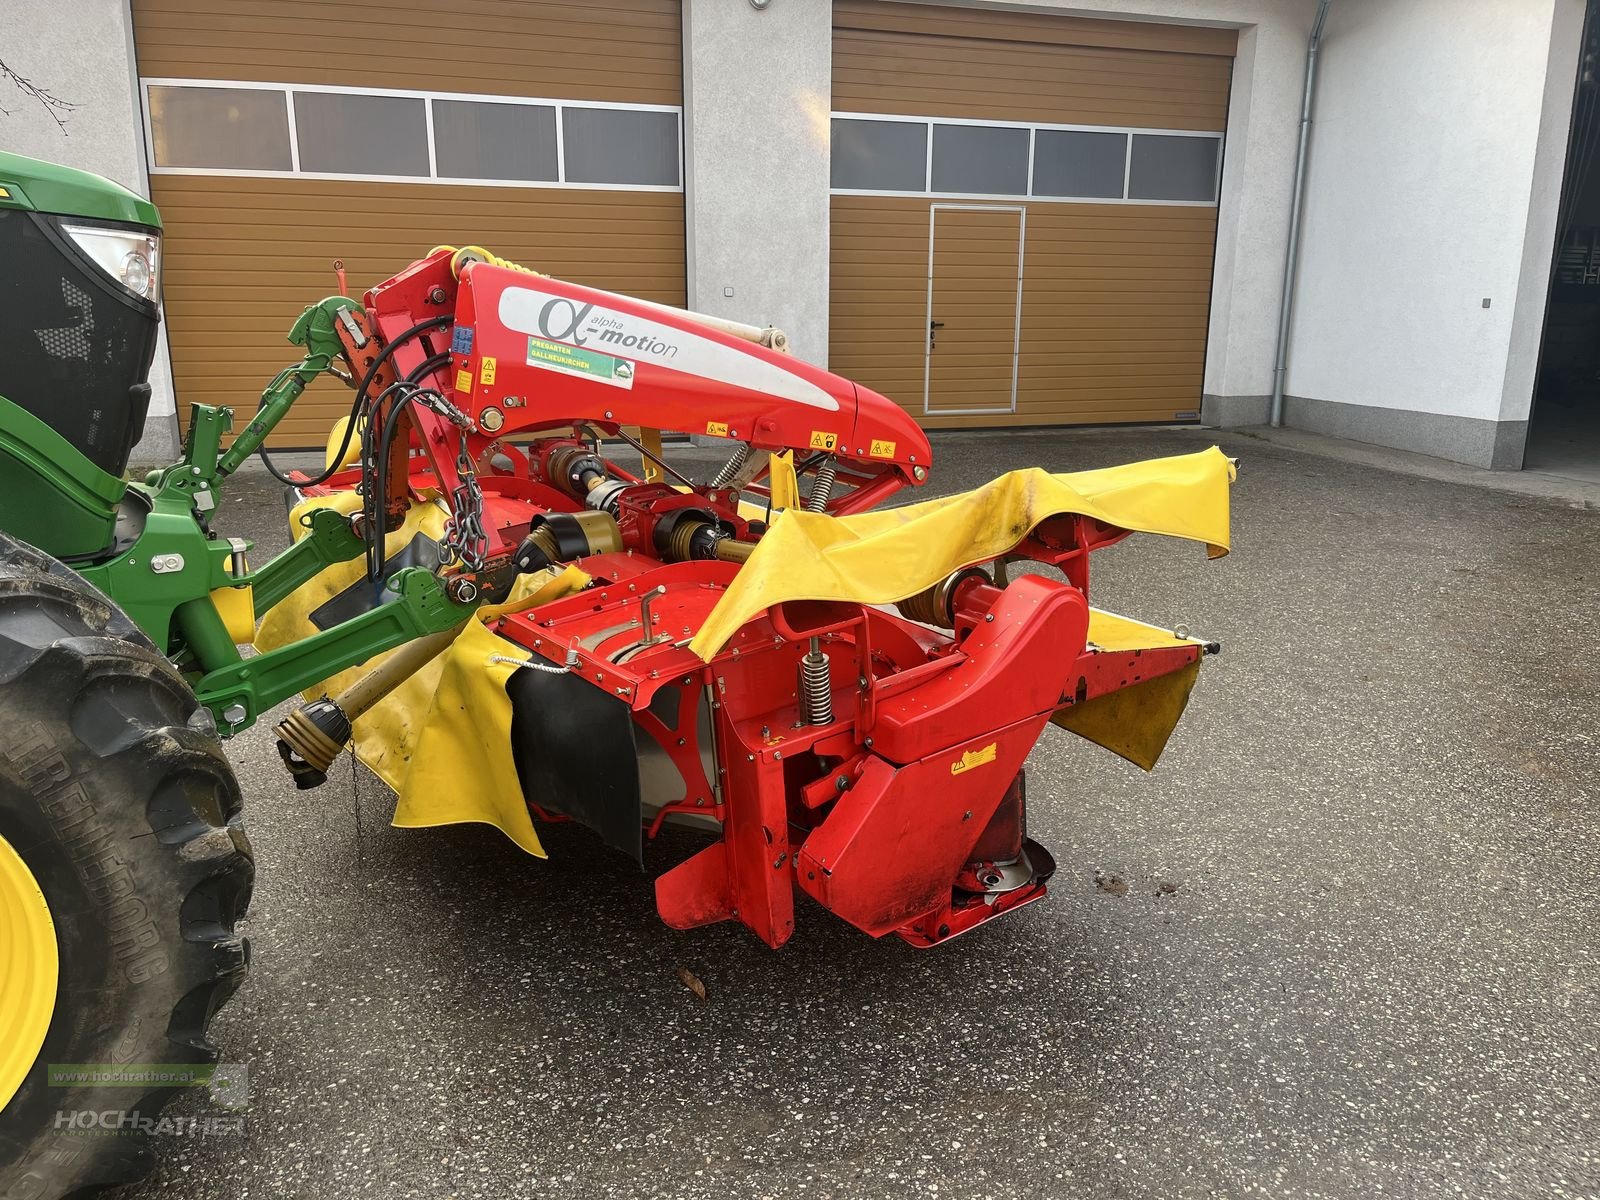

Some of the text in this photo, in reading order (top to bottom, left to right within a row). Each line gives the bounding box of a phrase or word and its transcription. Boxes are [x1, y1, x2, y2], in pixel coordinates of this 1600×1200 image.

[591, 315, 624, 330] alpha
[531, 339, 572, 355] PREGARTEN
[530, 349, 590, 369] GALLNEUKIRCHEN
[4, 720, 170, 984] TRELLEBORG
